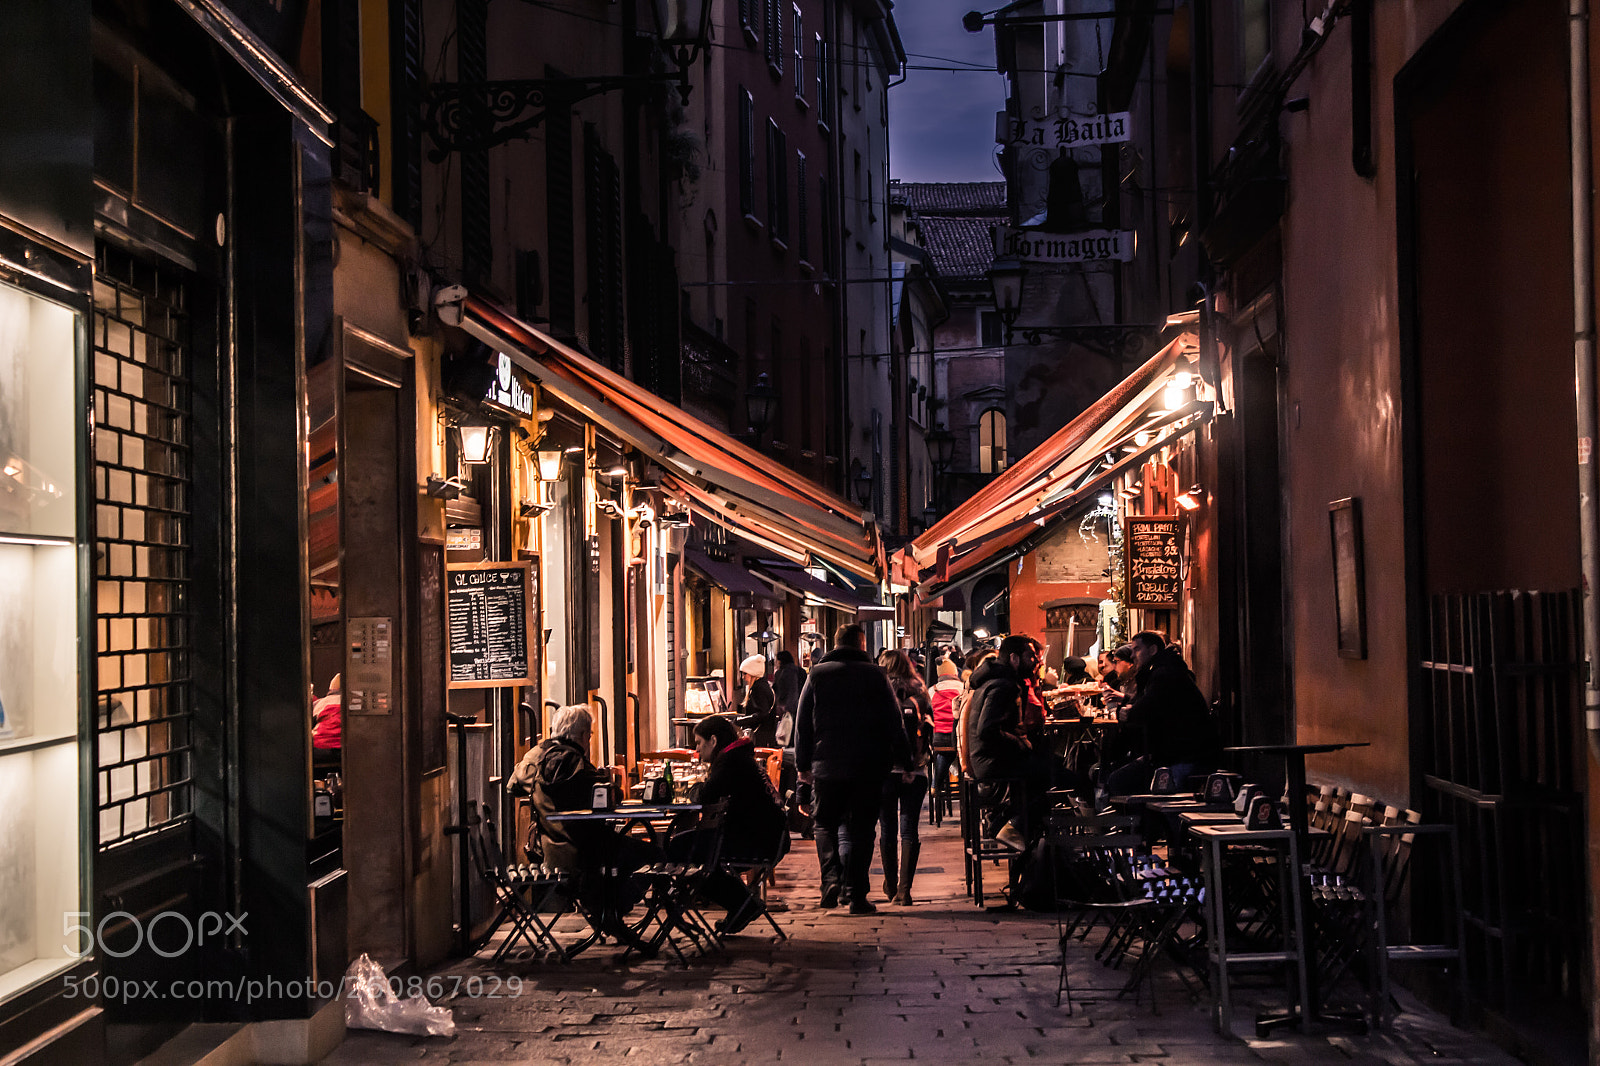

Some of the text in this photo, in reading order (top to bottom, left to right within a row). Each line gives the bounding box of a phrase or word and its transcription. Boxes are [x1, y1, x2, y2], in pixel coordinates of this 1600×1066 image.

[1010, 116, 1125, 147] La Baita
[1003, 229, 1120, 259] Formaggi
